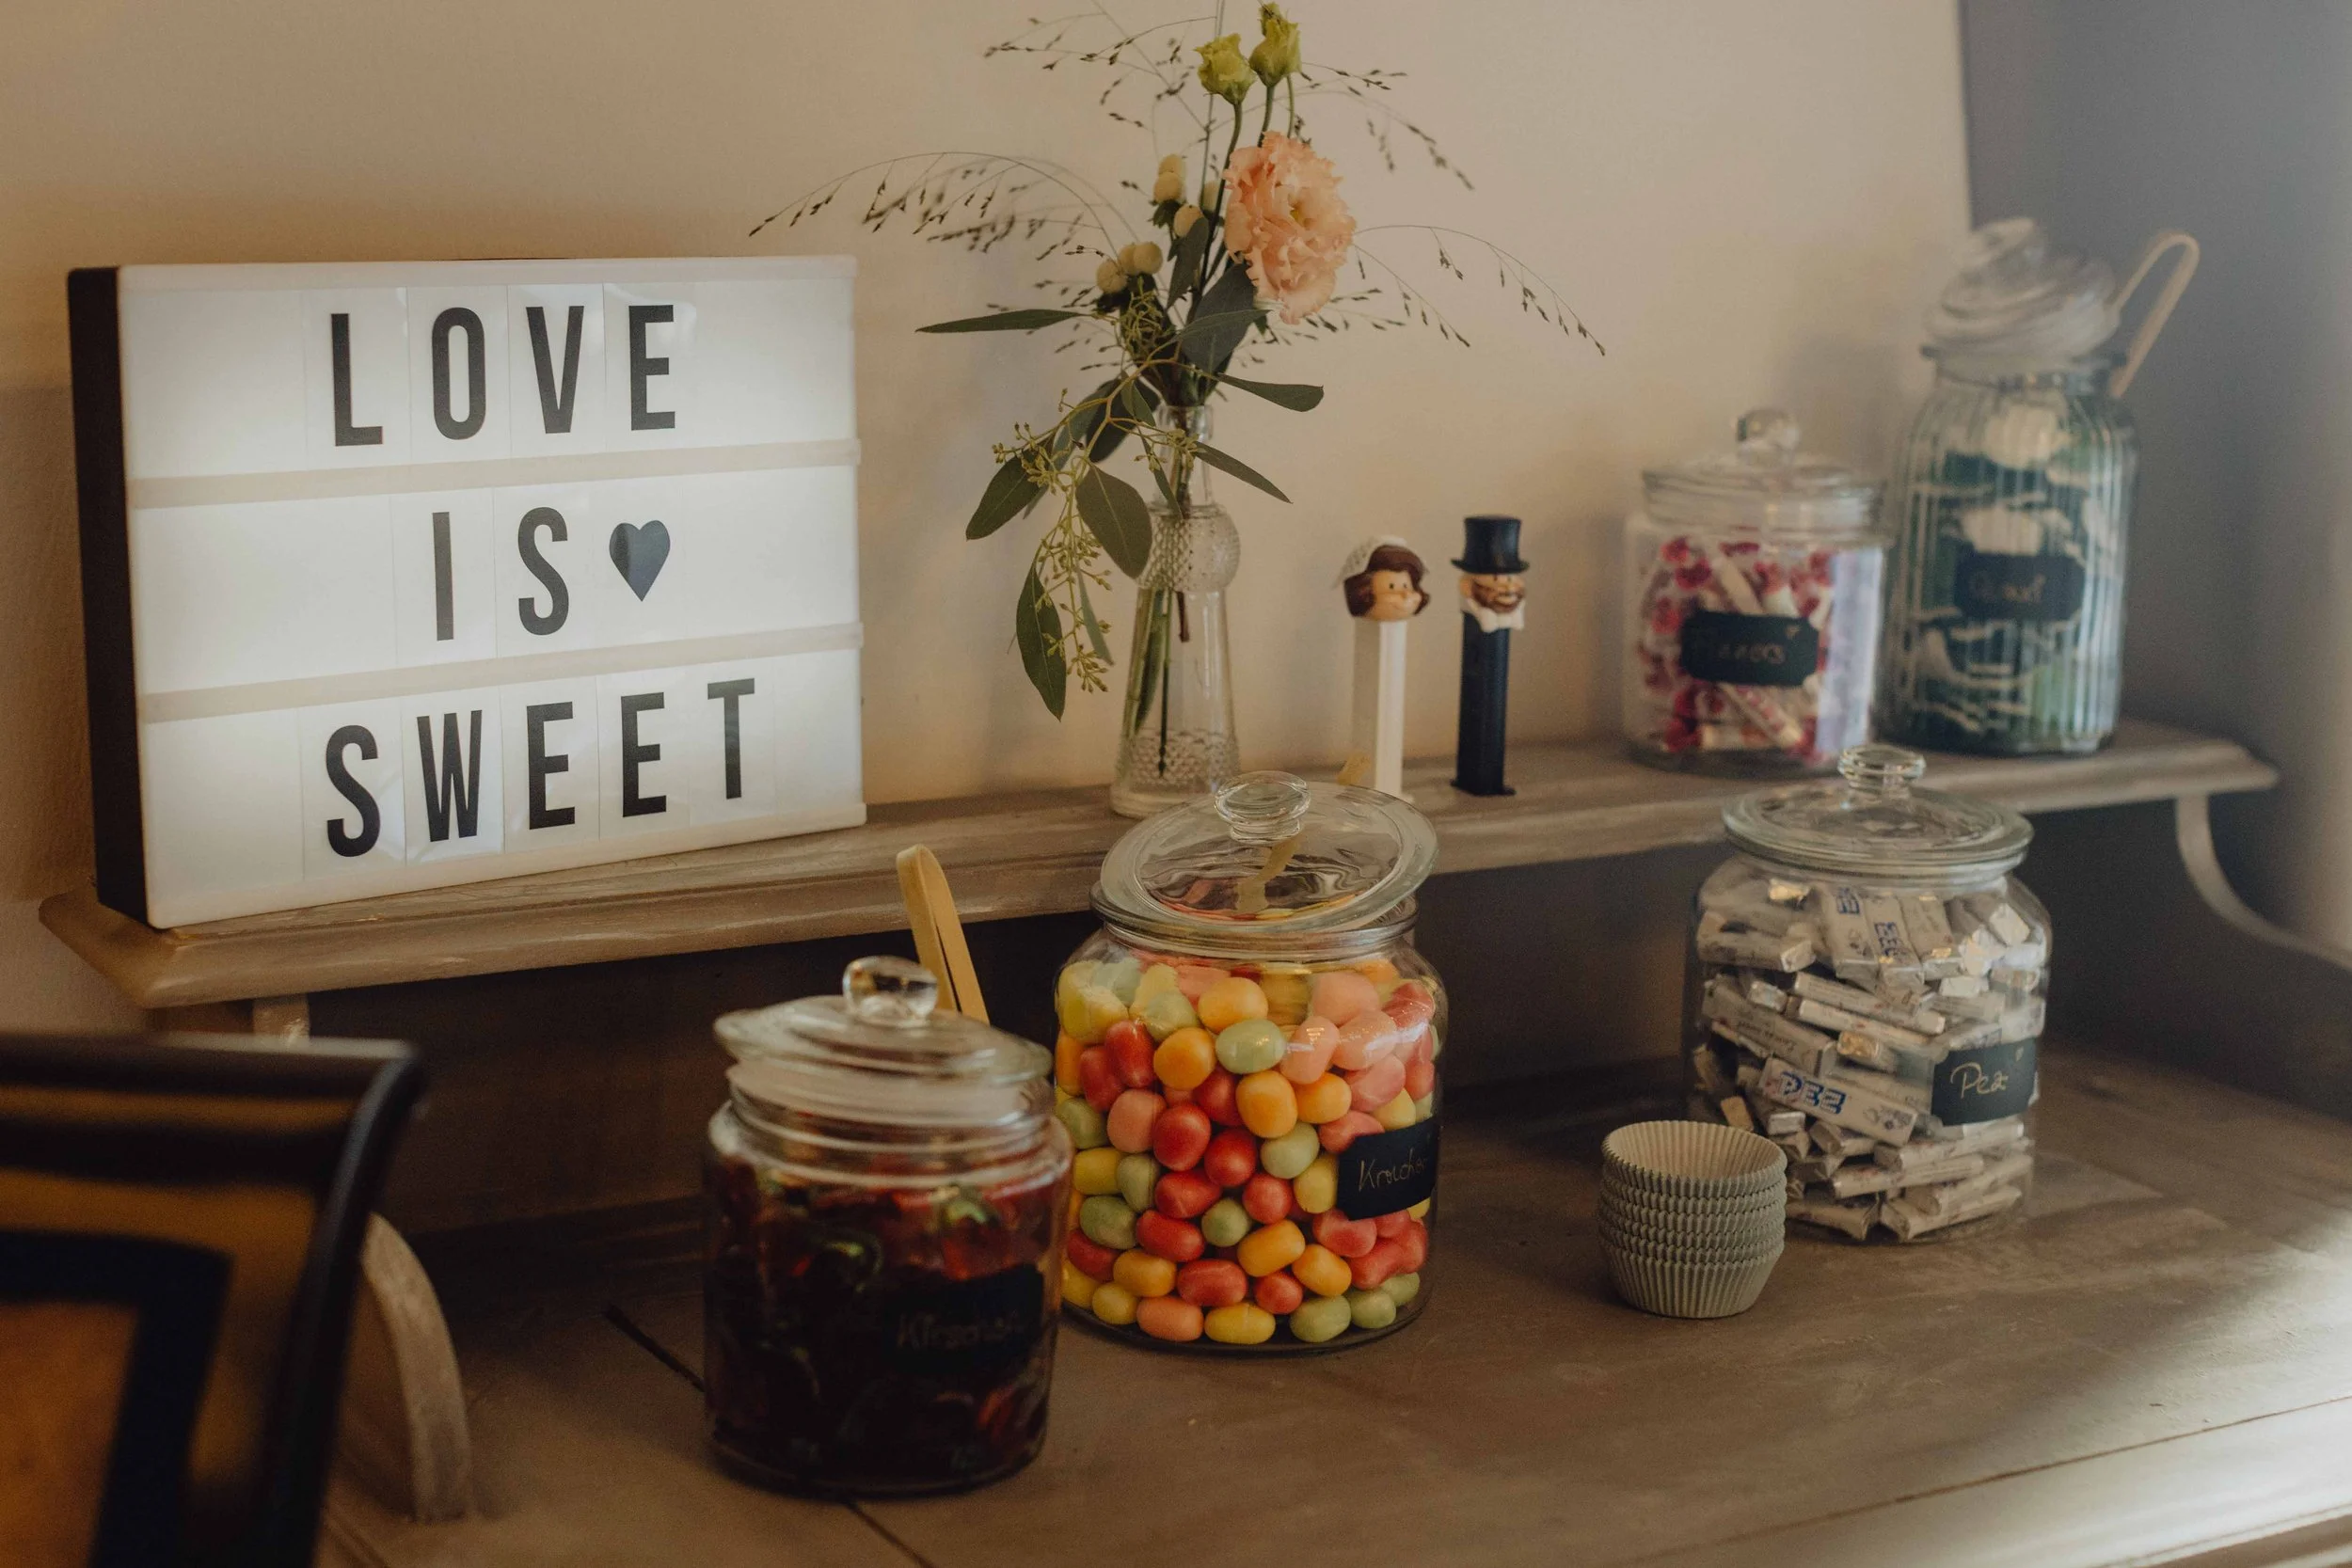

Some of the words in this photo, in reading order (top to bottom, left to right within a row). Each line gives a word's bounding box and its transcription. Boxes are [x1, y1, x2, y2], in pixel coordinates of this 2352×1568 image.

[330, 304, 676, 448] LOVE
[432, 506, 570, 641] IS
[325, 678, 755, 859] SWEET
[1778, 1069, 1848, 1116] PEZ
[1948, 1061, 2010, 1100] Pez
